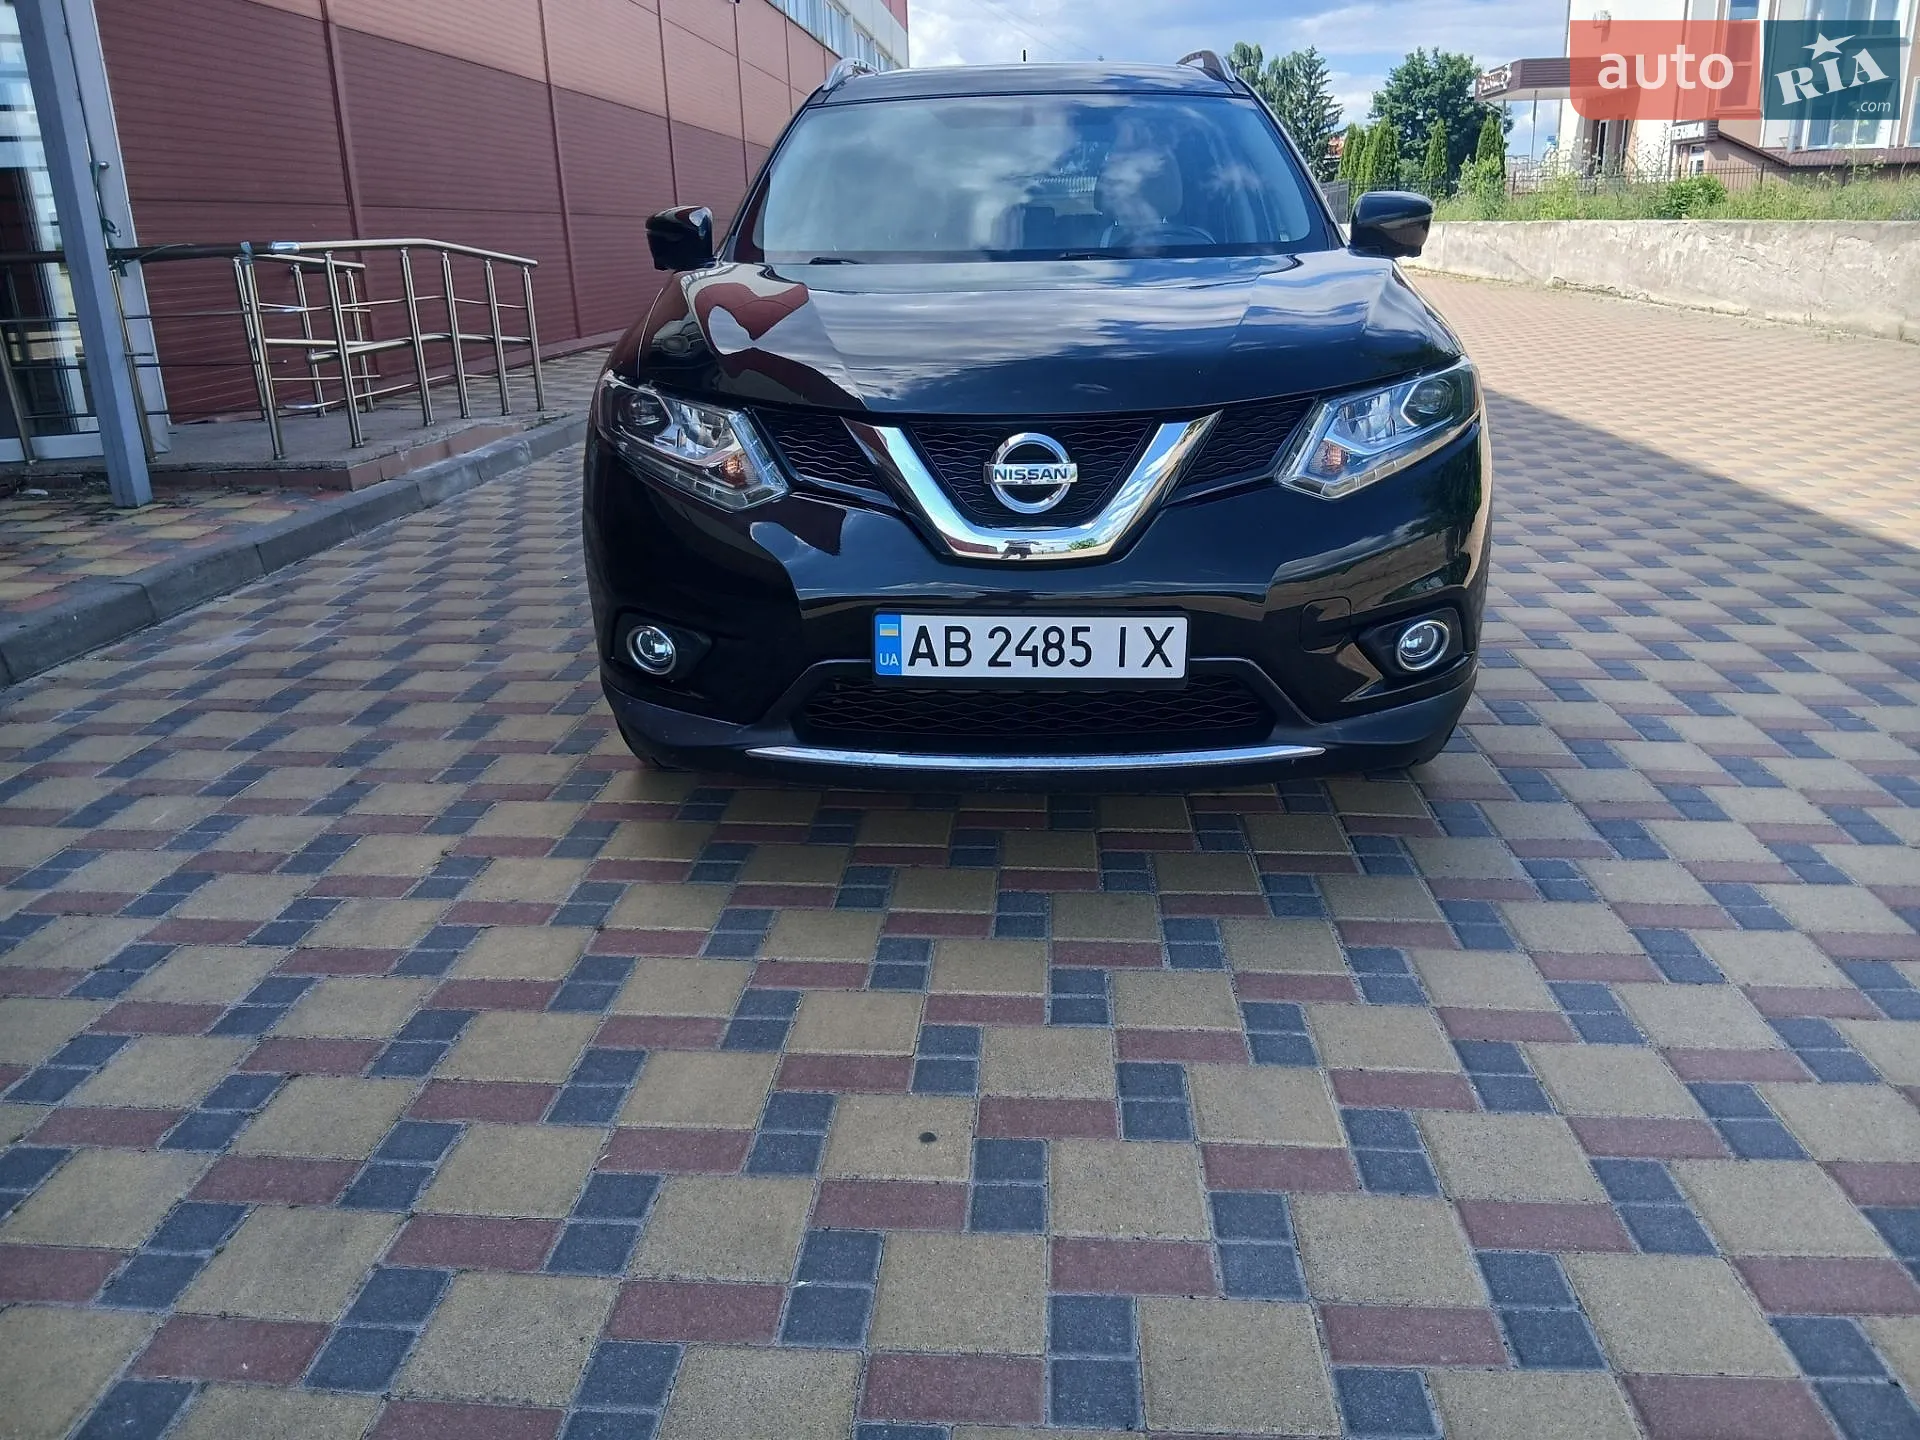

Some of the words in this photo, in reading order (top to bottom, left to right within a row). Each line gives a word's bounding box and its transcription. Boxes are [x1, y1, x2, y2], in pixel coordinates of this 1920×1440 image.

[994, 468, 1068, 481] NISSAN
[907, 625, 973, 668] AB
[987, 625, 1093, 669] 2485
[1118, 626, 1175, 668] IX
[879, 652, 900, 667] UA
